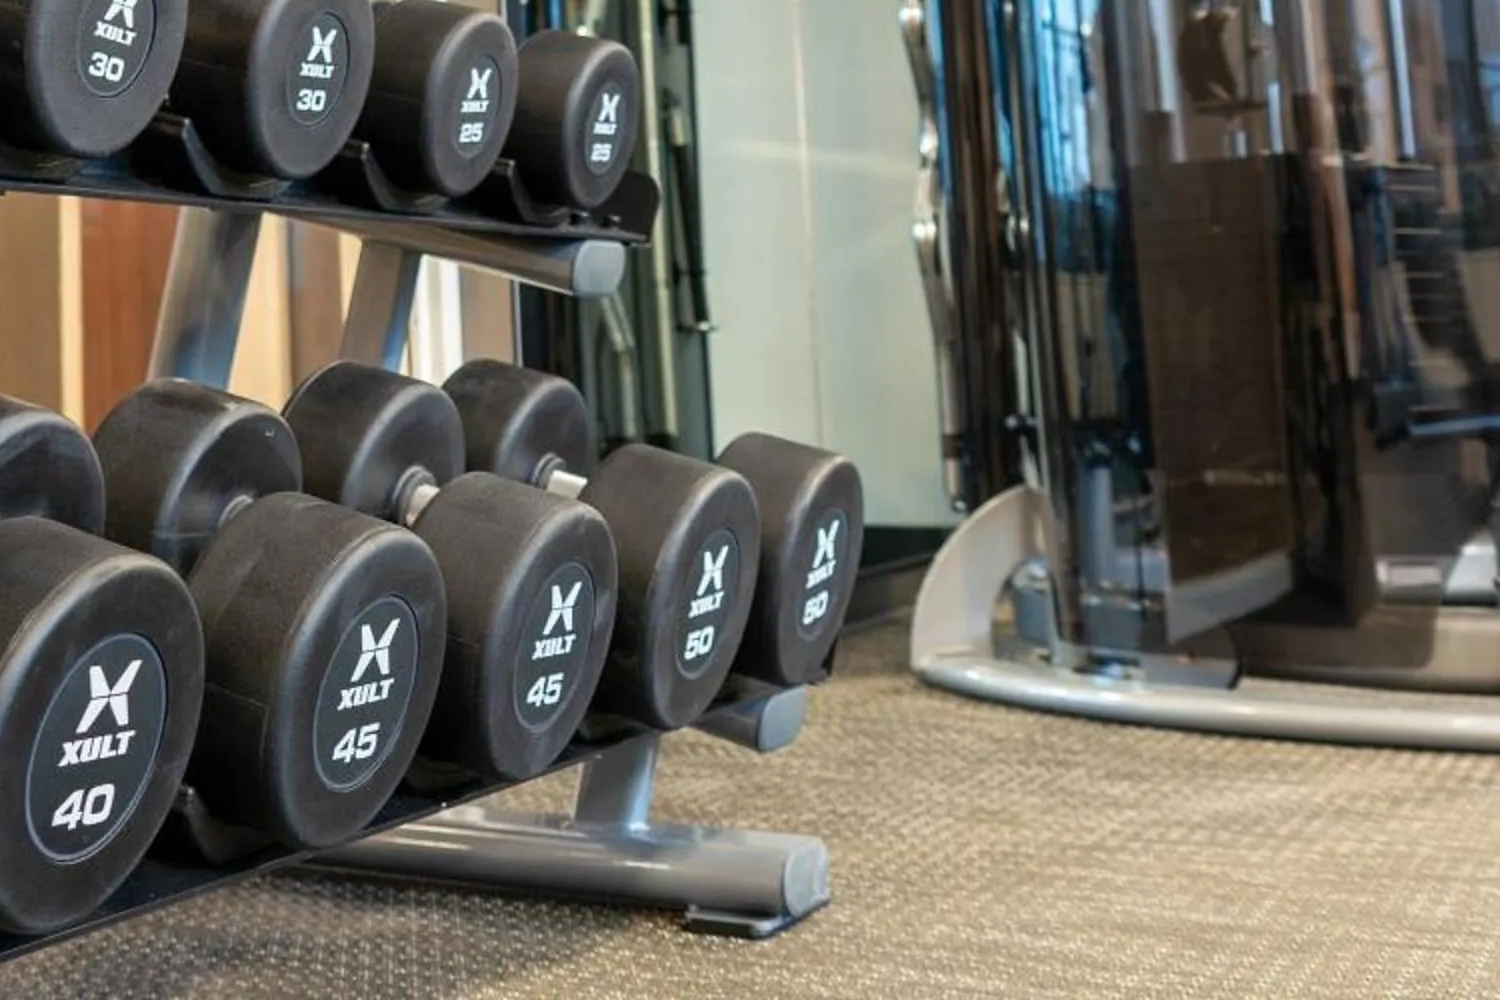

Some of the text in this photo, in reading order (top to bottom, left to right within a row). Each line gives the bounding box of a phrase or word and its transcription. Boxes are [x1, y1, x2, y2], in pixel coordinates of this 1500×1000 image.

[93, 20, 137, 47] XULT
[88, 51, 125, 83] 30
[299, 61, 335, 79] XULT
[296, 88, 327, 112] 30
[458, 121, 485, 143] 25
[531, 633, 577, 660] XULT
[683, 625, 715, 661] 50
[337, 677, 395, 711] XULT
[526, 672, 565, 707] 45
[58, 729, 136, 767] XULT
[331, 722, 380, 763] 45
[51, 783, 115, 830] 40
